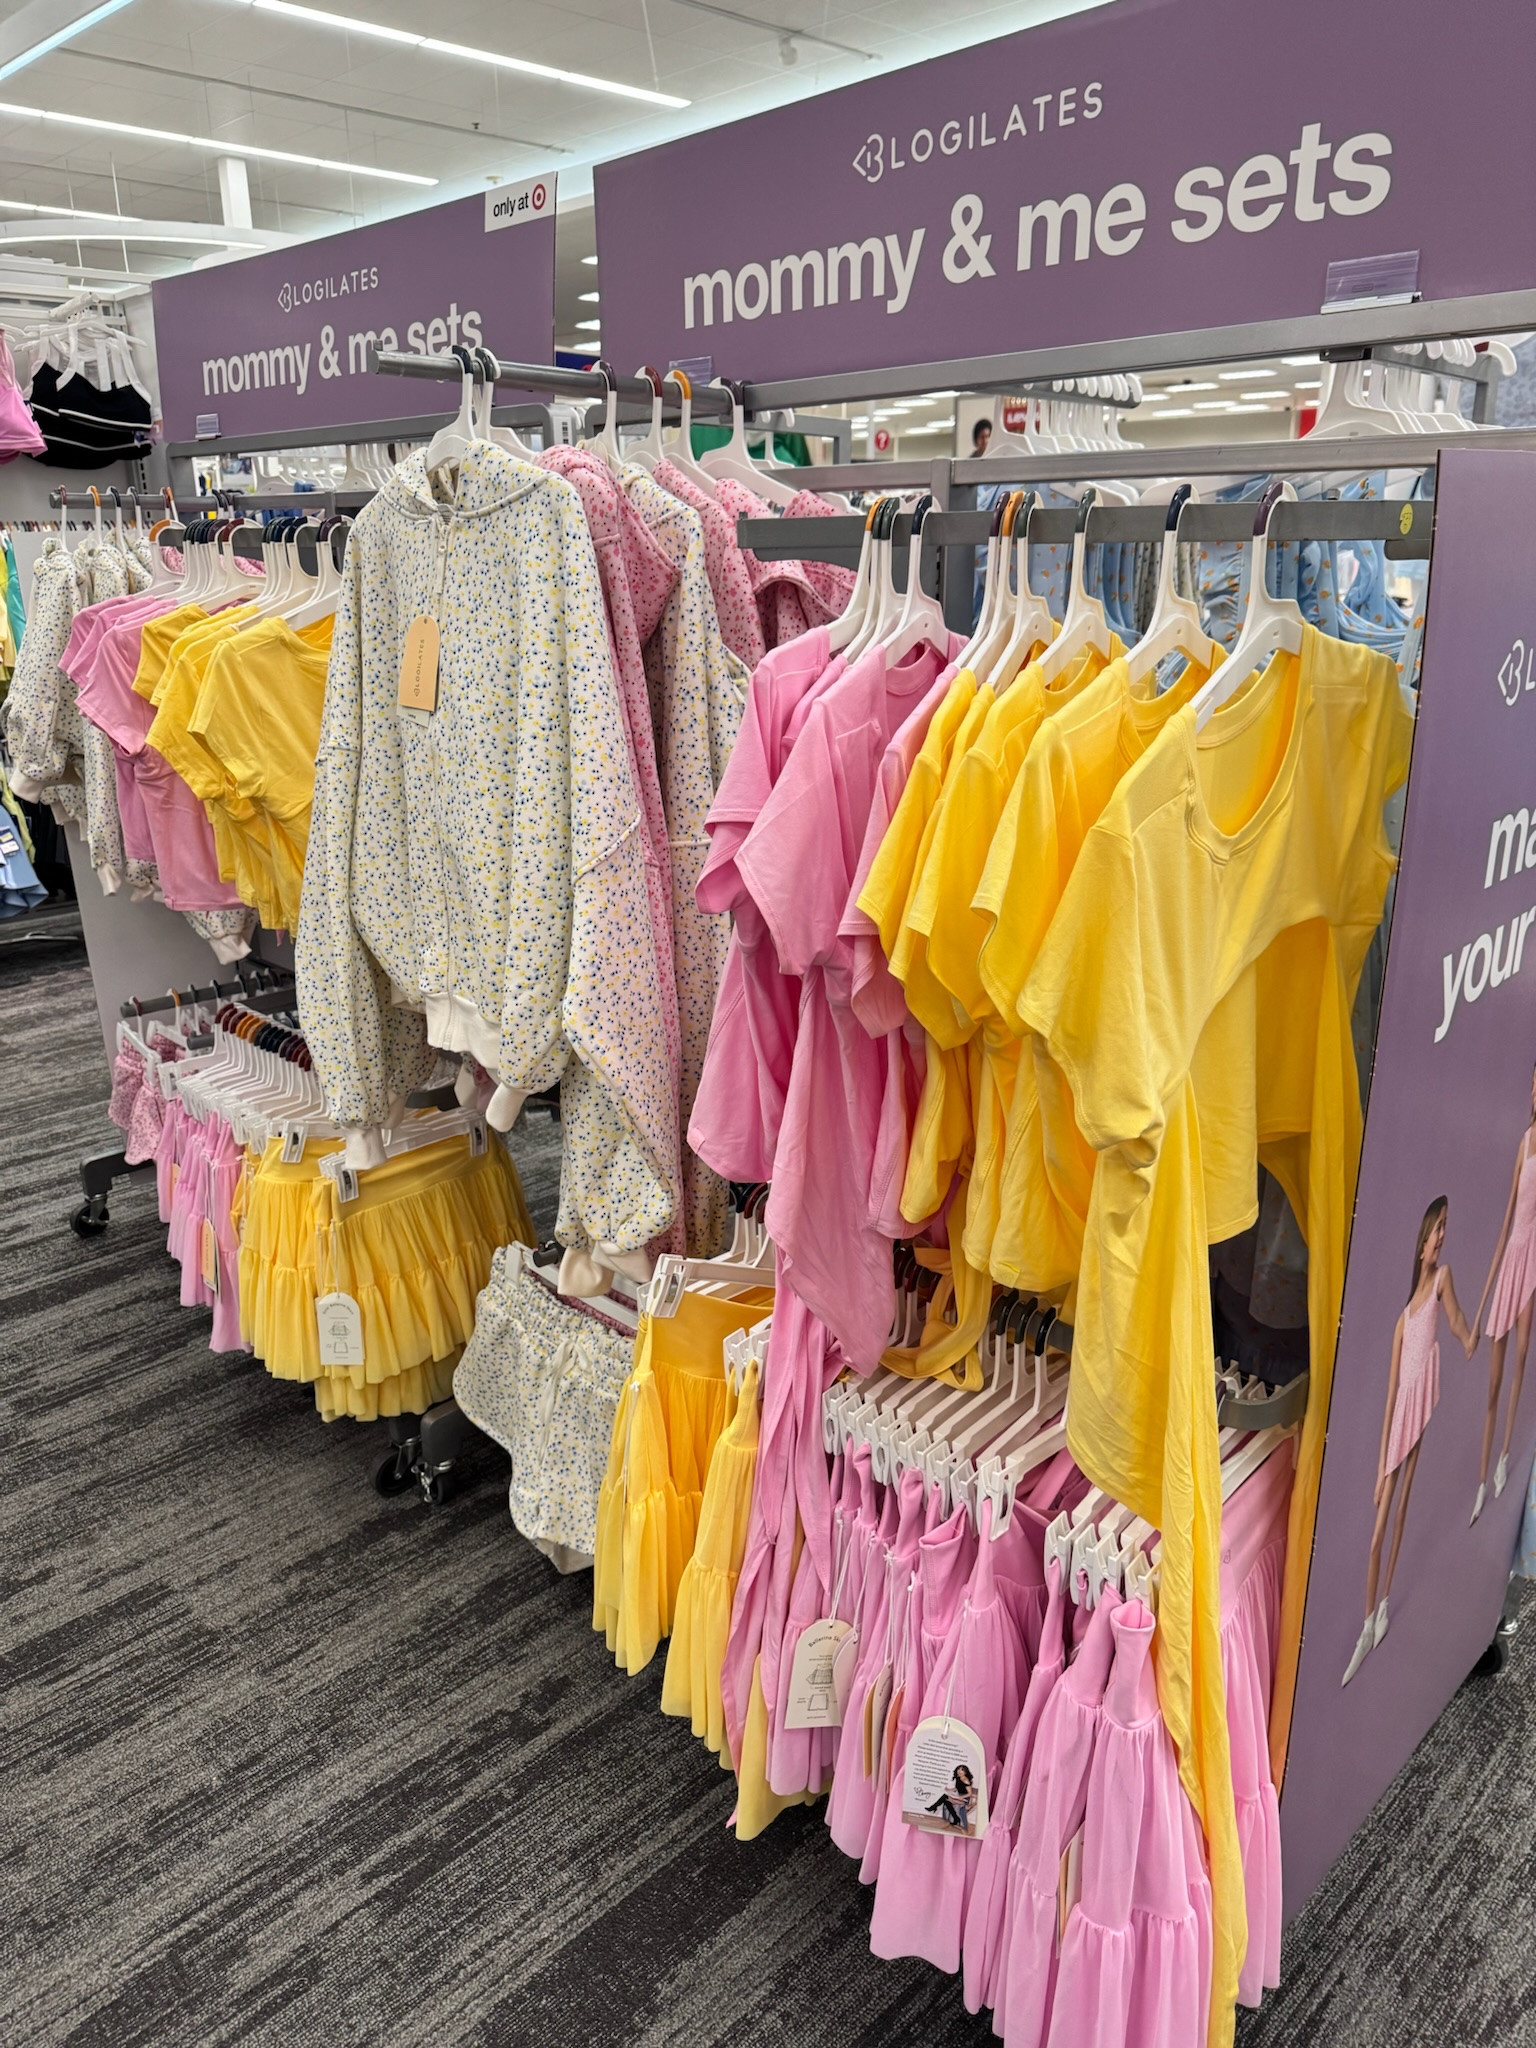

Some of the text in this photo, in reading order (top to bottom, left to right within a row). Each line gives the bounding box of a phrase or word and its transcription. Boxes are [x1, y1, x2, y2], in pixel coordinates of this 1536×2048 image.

[852, 82, 1103, 183] BLOGILATES
[493, 192, 529, 217] only at
[684, 122, 1393, 330] mommy & me sets
[277, 267, 380, 313] BLOGILATES
[202, 342, 311, 396] mommy
[318, 324, 342, 380] &
[406, 302, 483, 359] sets
[1433, 905, 1536, 1044] your
